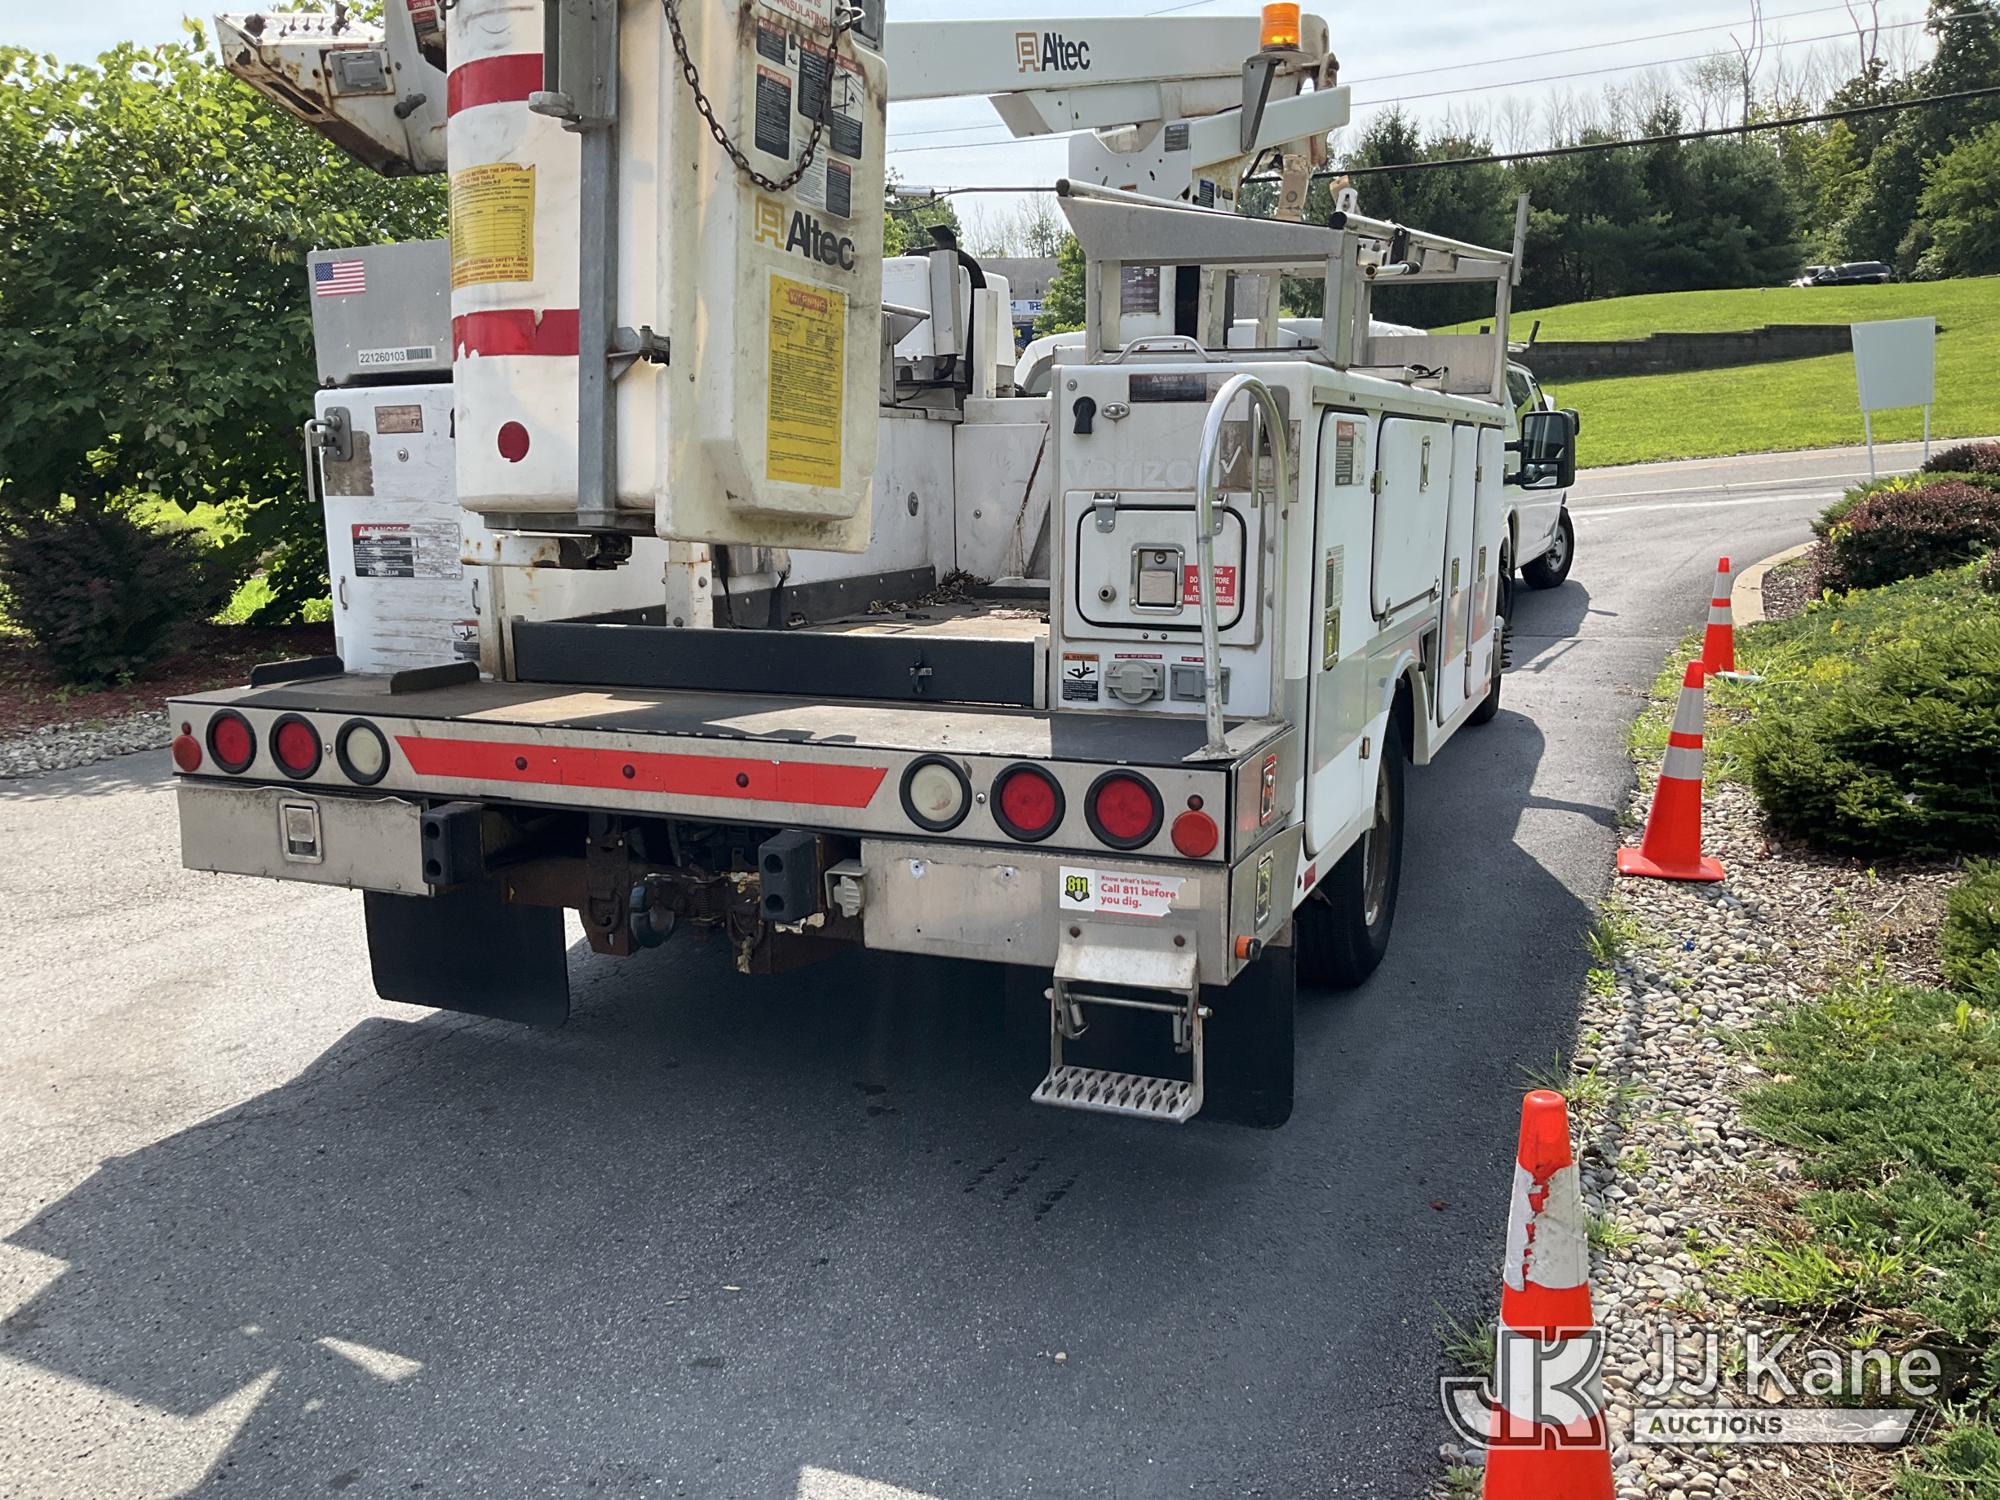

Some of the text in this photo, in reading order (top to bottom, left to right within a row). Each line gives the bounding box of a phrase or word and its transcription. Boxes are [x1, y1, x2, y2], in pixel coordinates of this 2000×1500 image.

[1041, 32, 1091, 71] Altec
[786, 210, 855, 271] Altec
[360, 351, 405, 363] 221260103
[1065, 459, 1198, 488] verizo
[1066, 875, 1088, 892] 811
[1141, 878, 1162, 887] below.
[1101, 883, 1176, 899] Call 811 before
[1101, 896, 1142, 908] you dig.
